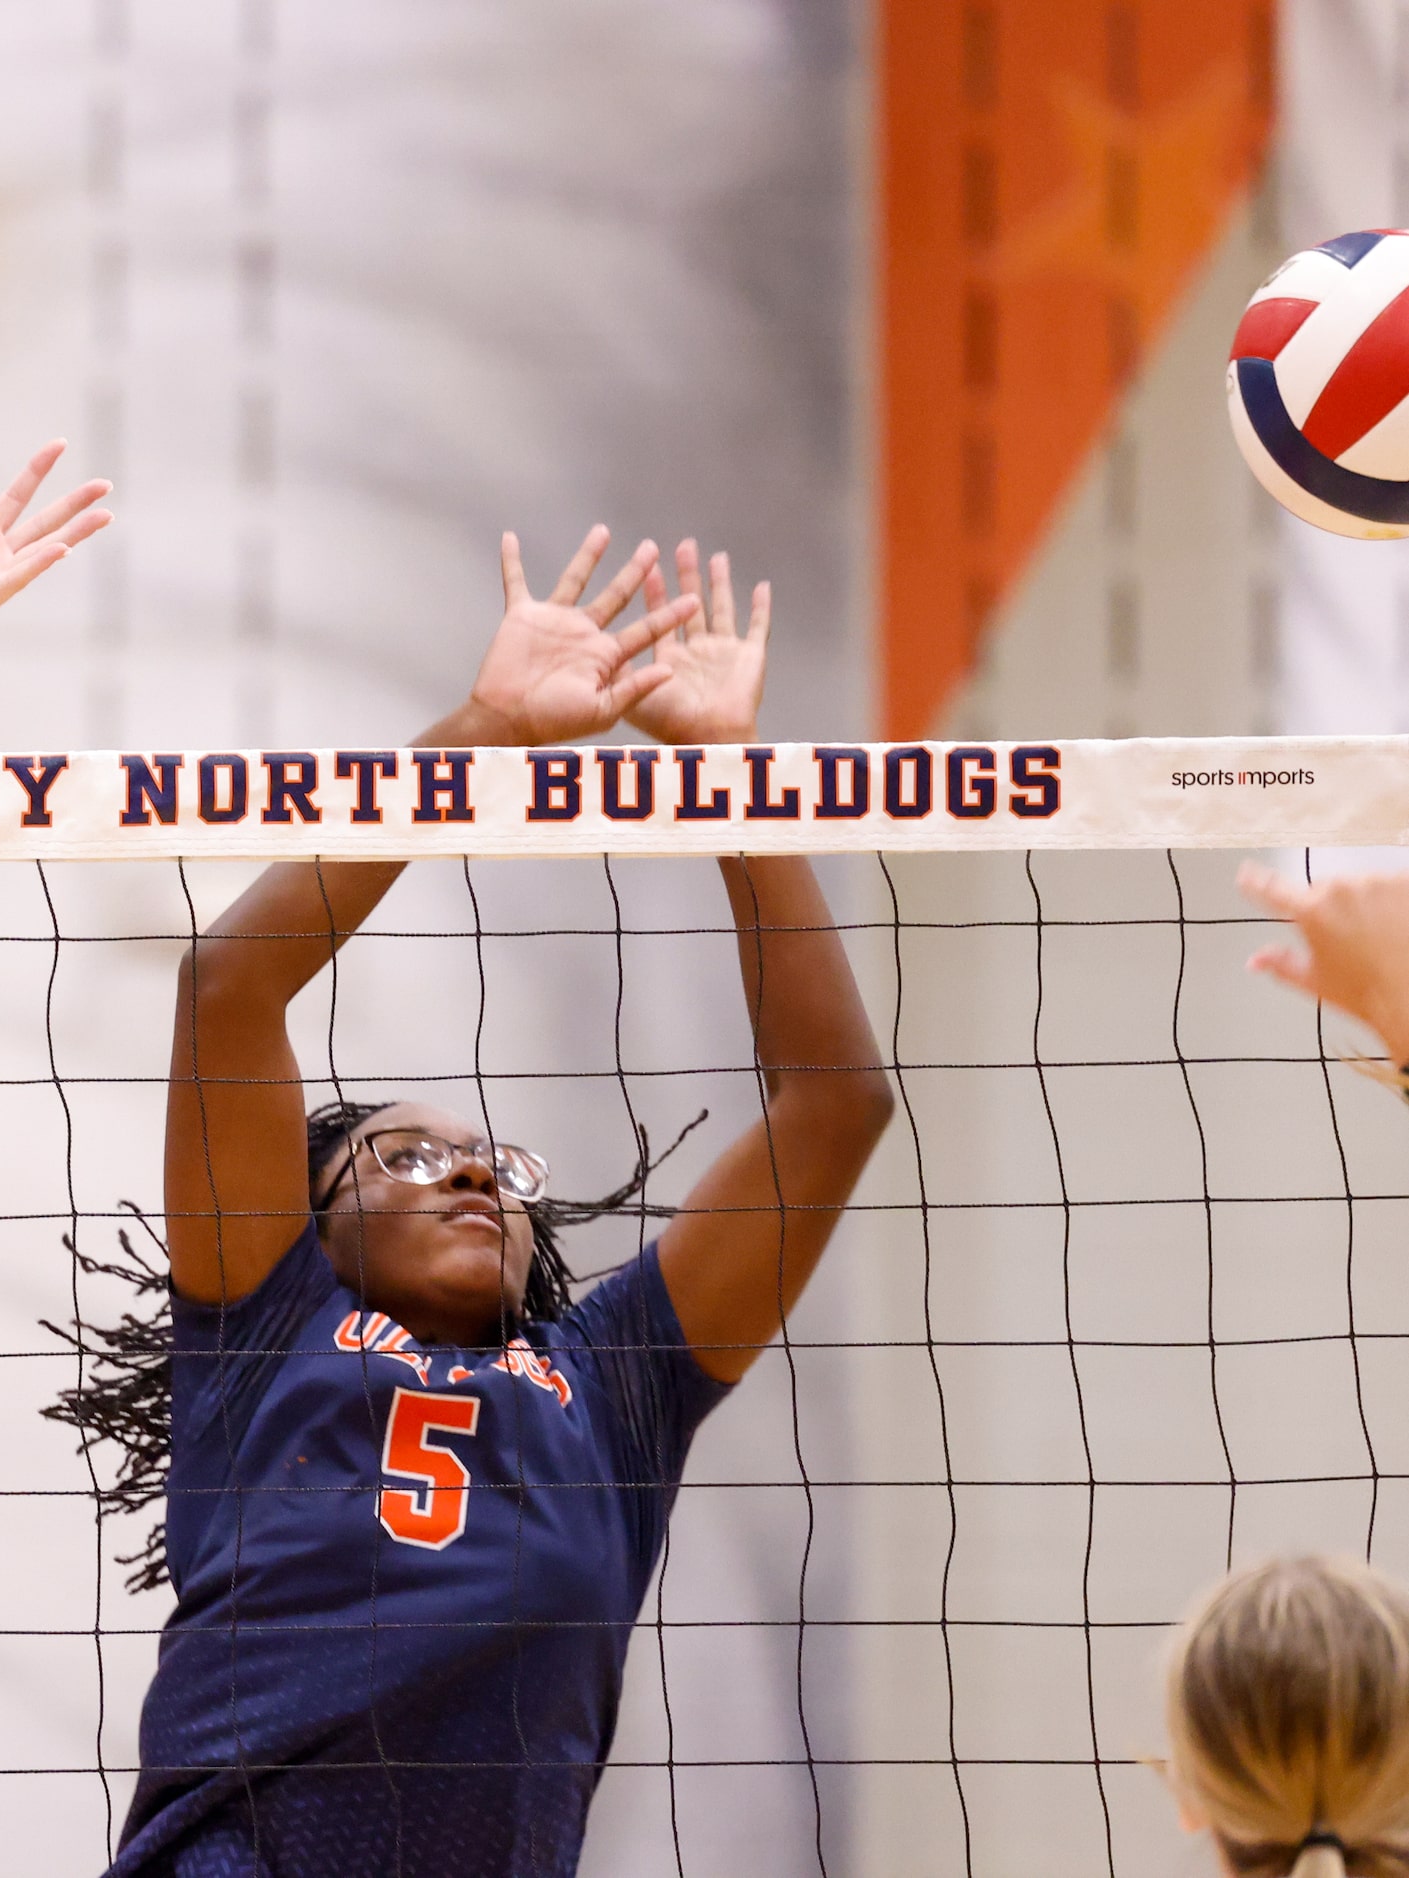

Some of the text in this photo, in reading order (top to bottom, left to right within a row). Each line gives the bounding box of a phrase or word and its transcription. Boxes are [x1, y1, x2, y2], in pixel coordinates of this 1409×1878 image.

[119, 749, 476, 828] NORTH
[526, 746, 1062, 823] BULLDOGS
[1171, 768, 1315, 789] sports imports
[374, 1386, 481, 1551] 5
